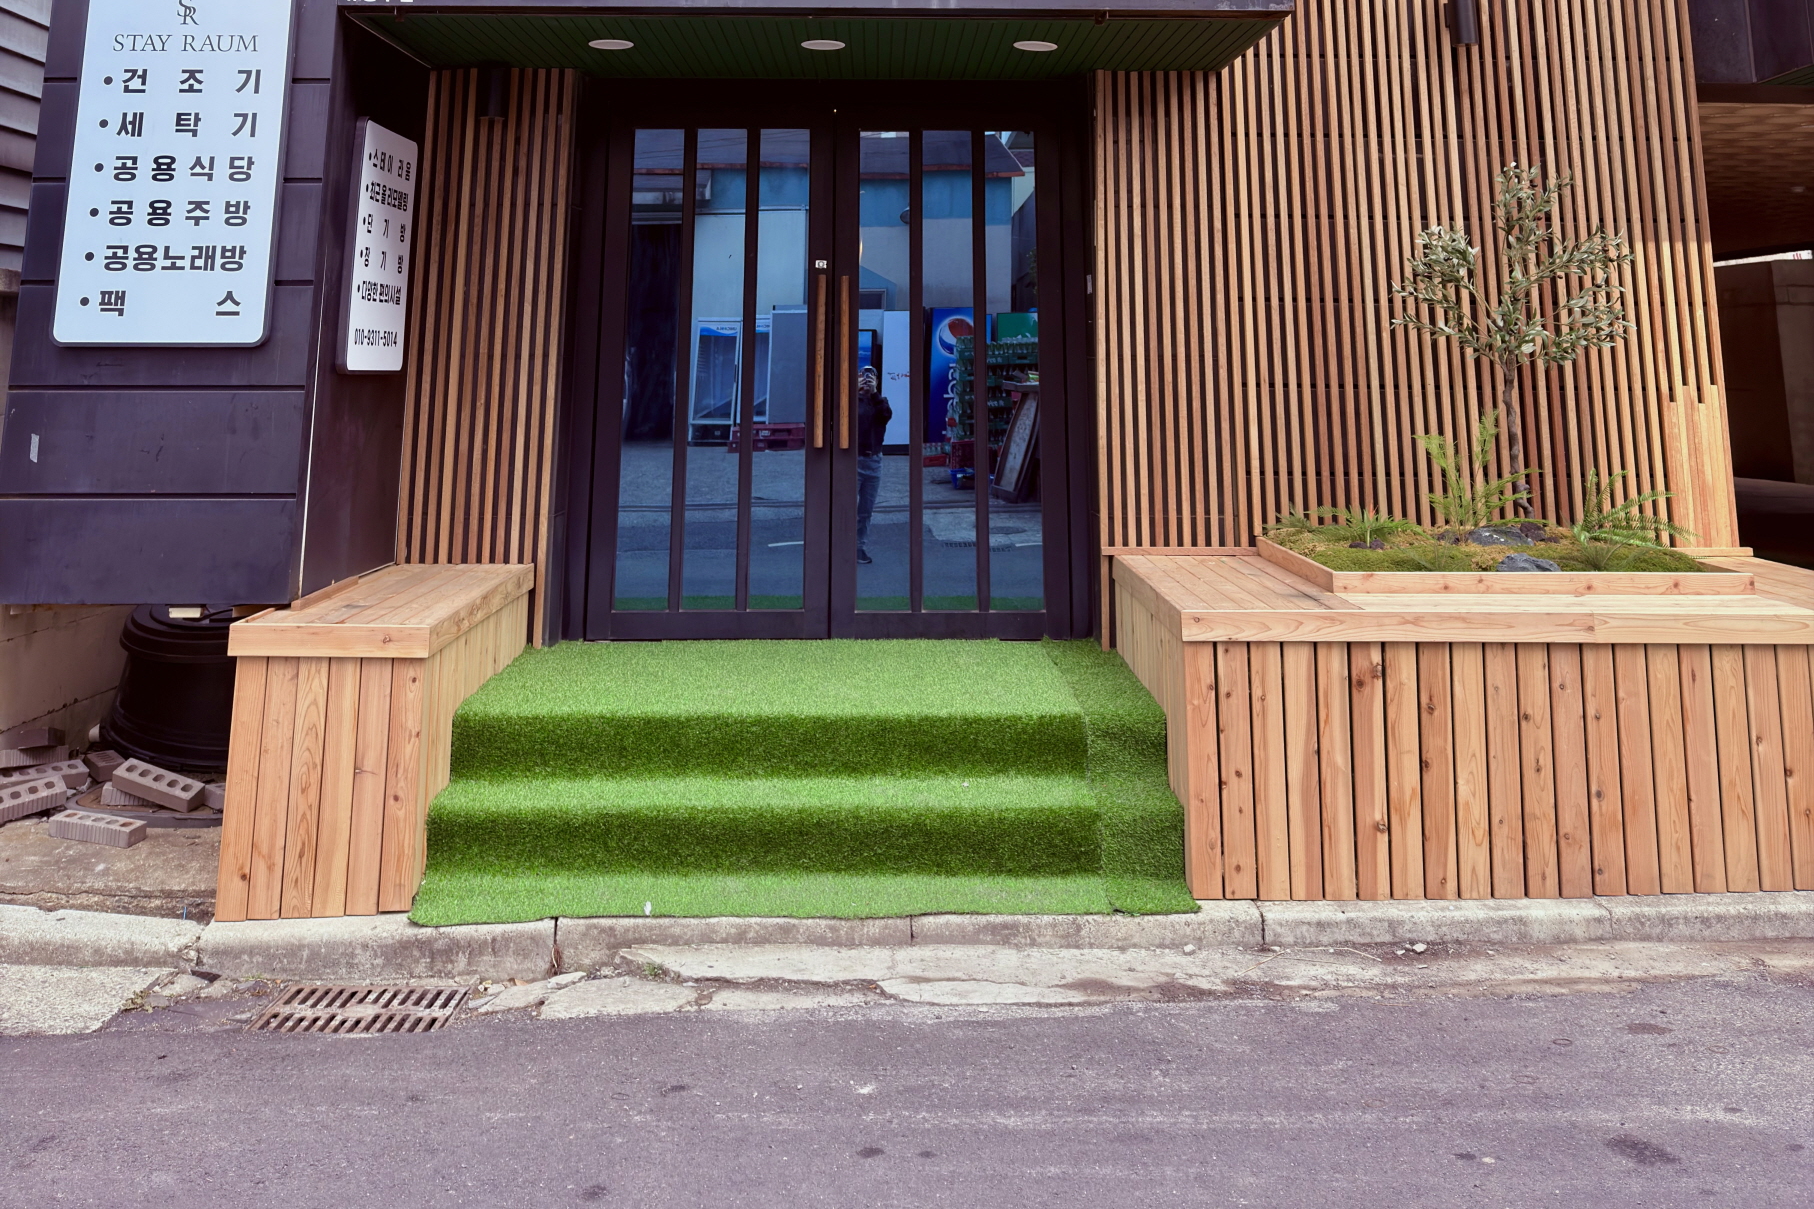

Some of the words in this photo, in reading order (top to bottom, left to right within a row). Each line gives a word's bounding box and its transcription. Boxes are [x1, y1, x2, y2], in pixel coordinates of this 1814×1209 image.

[112, 34, 173, 53] STAY
[180, 34, 258, 53] RAUM
[103, 244, 247, 272] 공용노래방
[354, 328, 398, 347] 010-9311-5014
